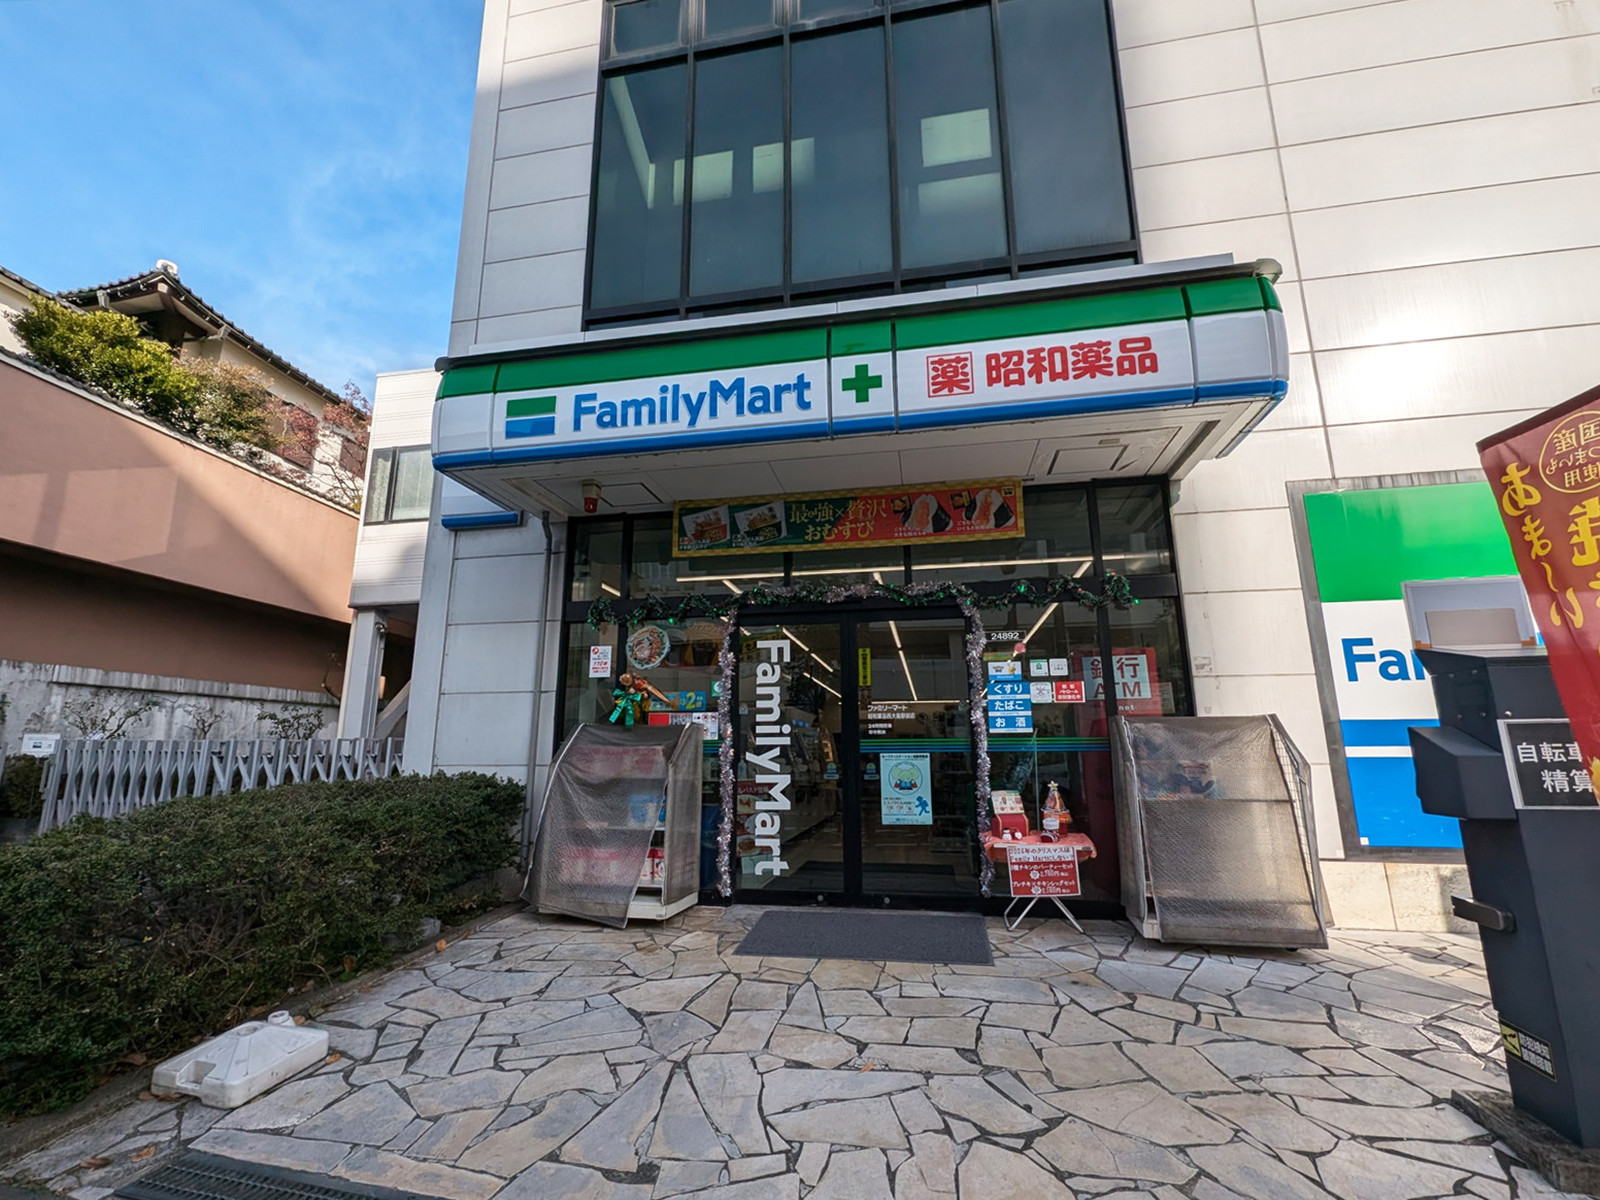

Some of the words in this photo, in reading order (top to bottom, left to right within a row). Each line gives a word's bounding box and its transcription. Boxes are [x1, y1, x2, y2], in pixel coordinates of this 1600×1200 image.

[985, 336, 1159, 388] 昭和薬品
[930, 357, 971, 394] 薬
[573, 373, 812, 433] FamilyMart
[804, 520, 877, 543] おむすび
[991, 632, 1020, 640] 24892
[993, 684, 1023, 694] くすり
[1094, 681, 1142, 698] AM
[994, 700, 1025, 711] たばこ
[746, 639, 792, 876] FamilyMart
